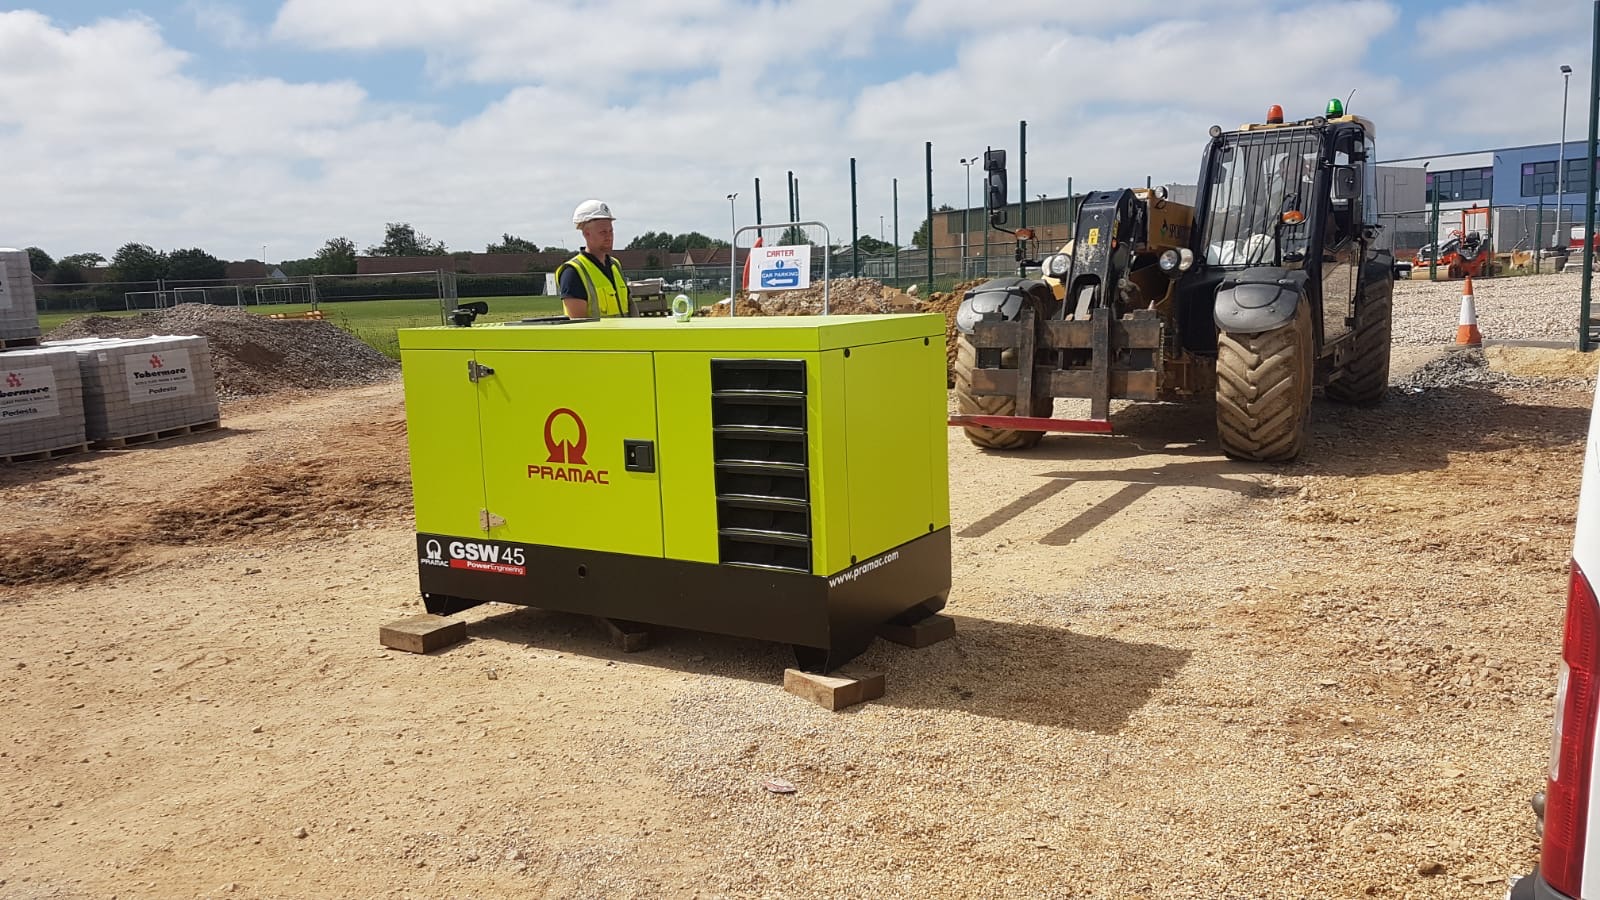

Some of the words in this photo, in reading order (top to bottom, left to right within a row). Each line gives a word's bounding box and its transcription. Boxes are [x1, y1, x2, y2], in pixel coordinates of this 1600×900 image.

[766, 249, 794, 257] CARTER
[133, 367, 186, 379] Tobermore
[0, 386, 49, 398] bermore
[527, 464, 609, 485] PRAMAC
[448, 541, 499, 563] GSW
[501, 547, 526, 566] 45
[420, 558, 449, 567] PRAMAC
[828, 550, 899, 588] www.pramac.com
